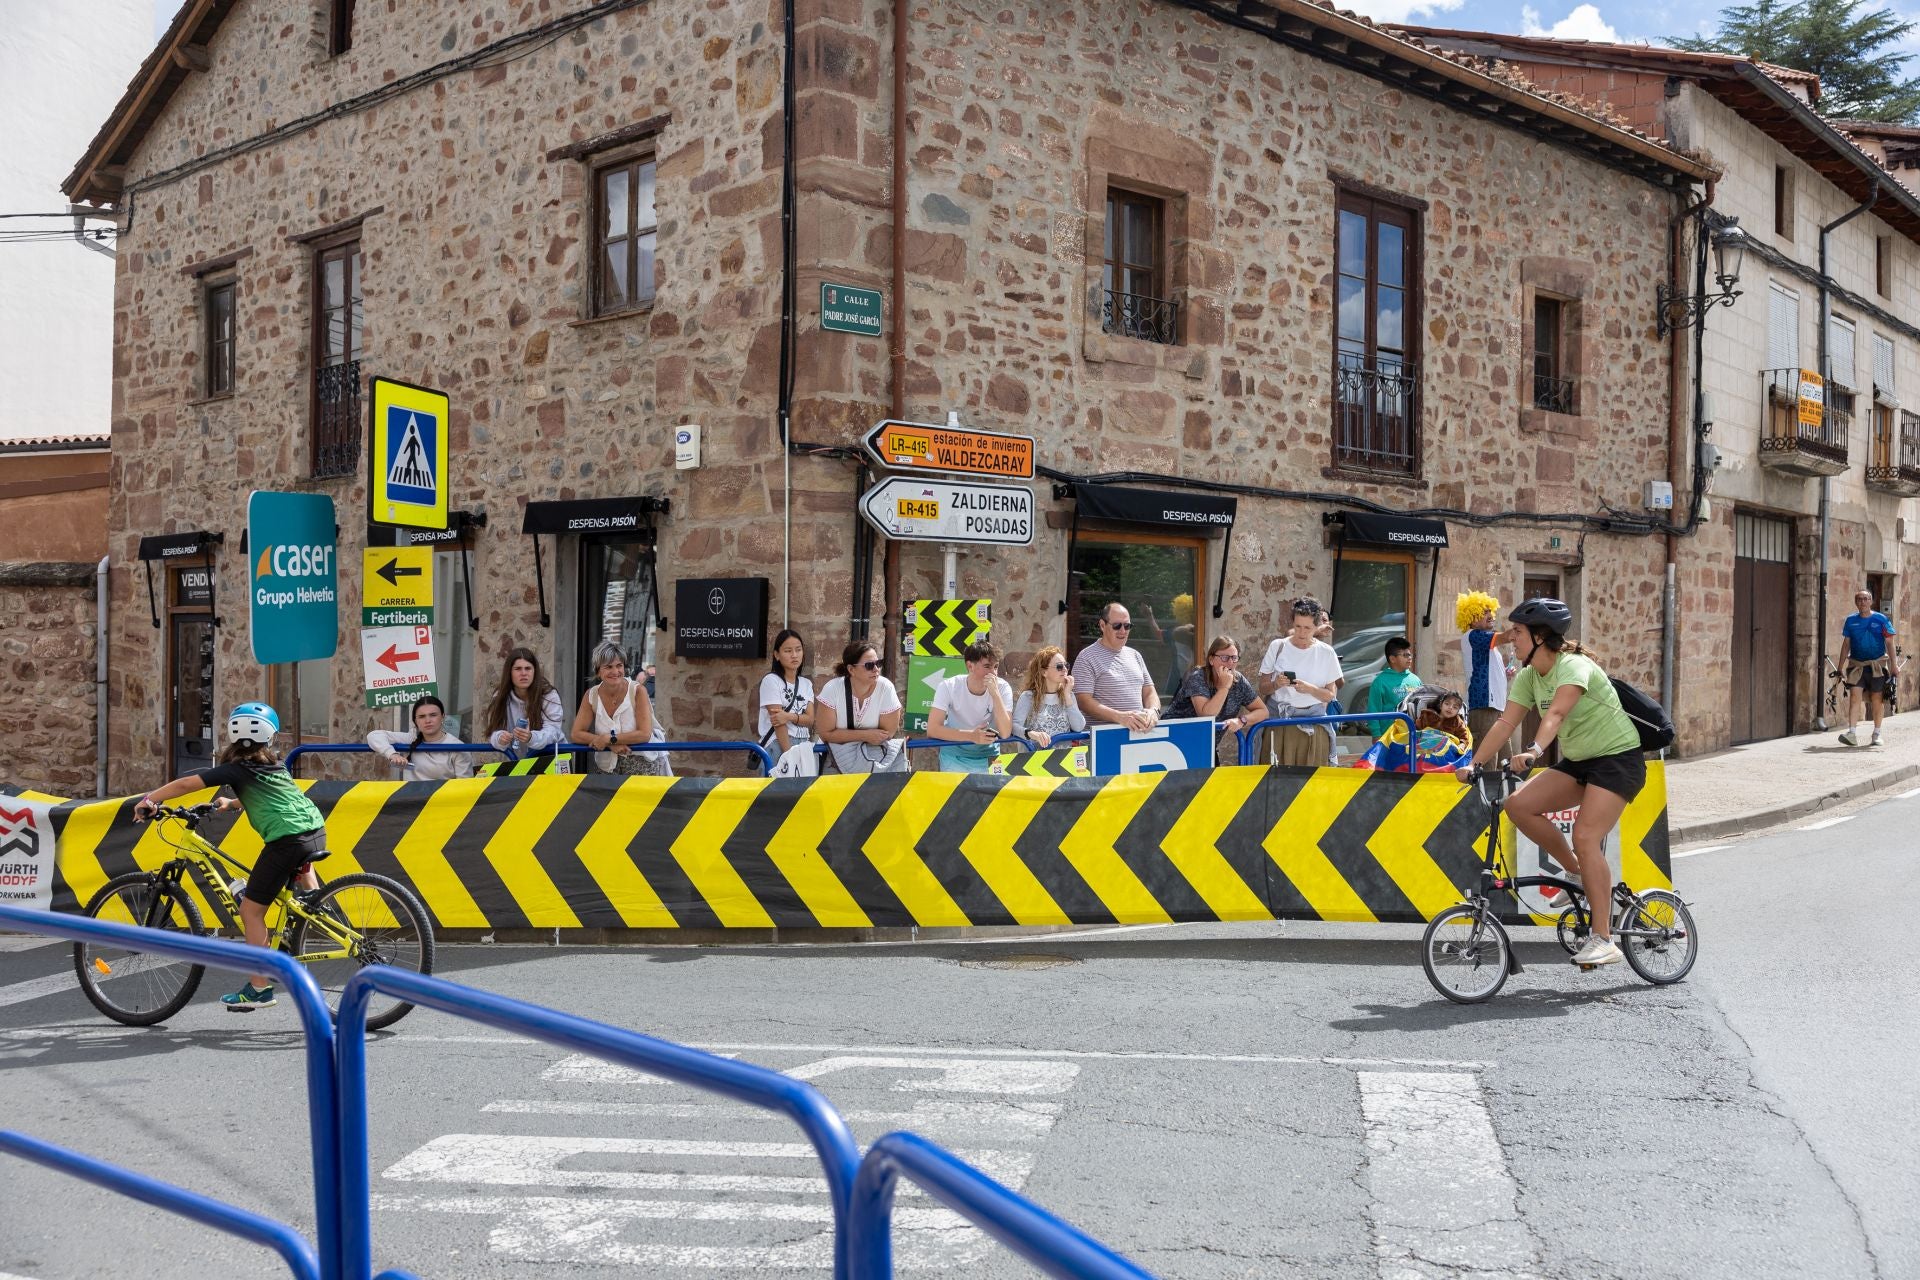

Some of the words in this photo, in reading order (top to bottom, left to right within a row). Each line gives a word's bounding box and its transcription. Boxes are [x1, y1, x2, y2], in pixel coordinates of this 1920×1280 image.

[844, 295, 869, 306] CALLE
[825, 310, 844, 321] PADRE
[844, 313, 859, 323] JOSÉ
[860, 315, 880, 326] GARCÍA
[891, 437, 927, 454] LR-415
[933, 433, 973, 448] estación
[976, 436, 988, 448] de
[991, 437, 1027, 453] invierno
[937, 448, 1025, 473] VALDEZCARAY
[899, 502, 937, 517] LR-415
[951, 492, 1028, 513] ZALDIERNA
[568, 518, 610, 529] DESPENSA
[611, 513, 637, 527] PISÓN
[1163, 510, 1207, 523] DESPENSA
[1209, 511, 1232, 524] PISÓN
[966, 516, 1028, 536] POSADAS
[410, 532, 436, 542] SPENSA
[437, 528, 457, 539] PISÓN
[1388, 532, 1425, 543] DESPENSA
[1425, 533, 1446, 544] PISÓN
[162, 547, 185, 556] DESPENSA
[273, 544, 333, 577] caser
[256, 588, 294, 609] Grupo
[297, 586, 334, 603] Helvetia
[380, 598, 416, 606] CARRERA
[371, 610, 428, 624] Fertiberia
[416, 627, 428, 644] P
[680, 627, 725, 638] DESPENSA
[727, 624, 754, 638] PISÓN
[372, 677, 406, 688] EQUIPOS
[408, 674, 430, 683] META
[0, 875, 38, 886] ODYF
